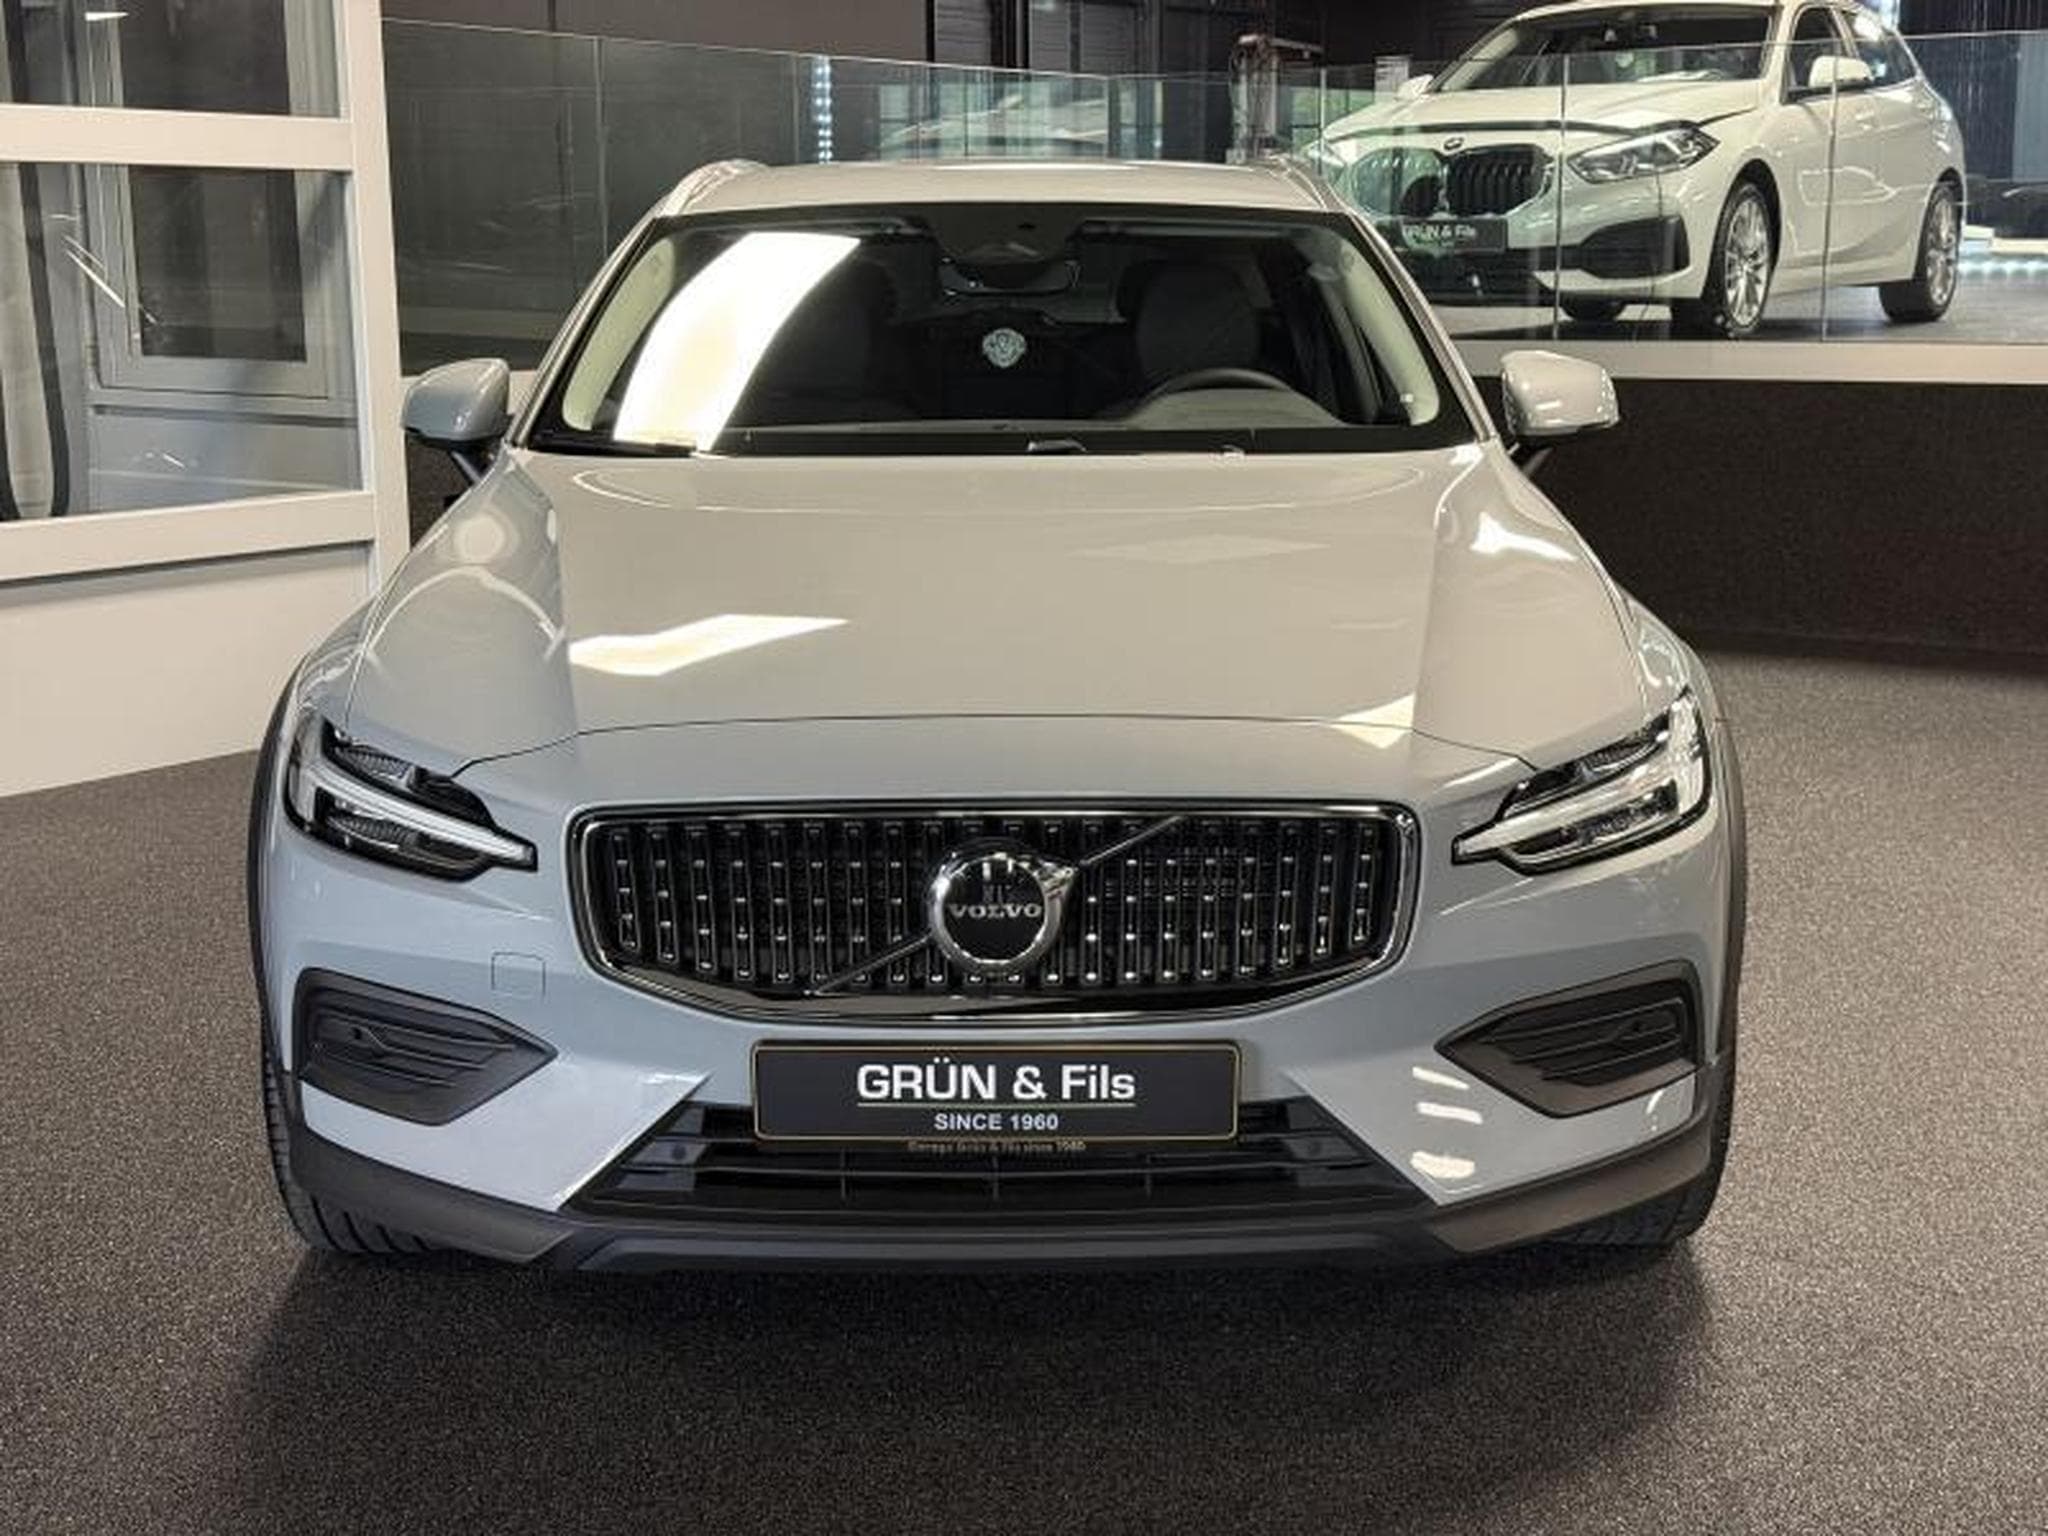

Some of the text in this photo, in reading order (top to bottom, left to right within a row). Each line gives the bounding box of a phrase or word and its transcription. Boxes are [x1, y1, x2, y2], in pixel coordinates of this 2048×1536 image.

[949, 903, 1042, 919] VOLVO
[857, 1056, 1136, 1100] GRÜN & Fils
[933, 1113, 1060, 1131] SINCE 1960
